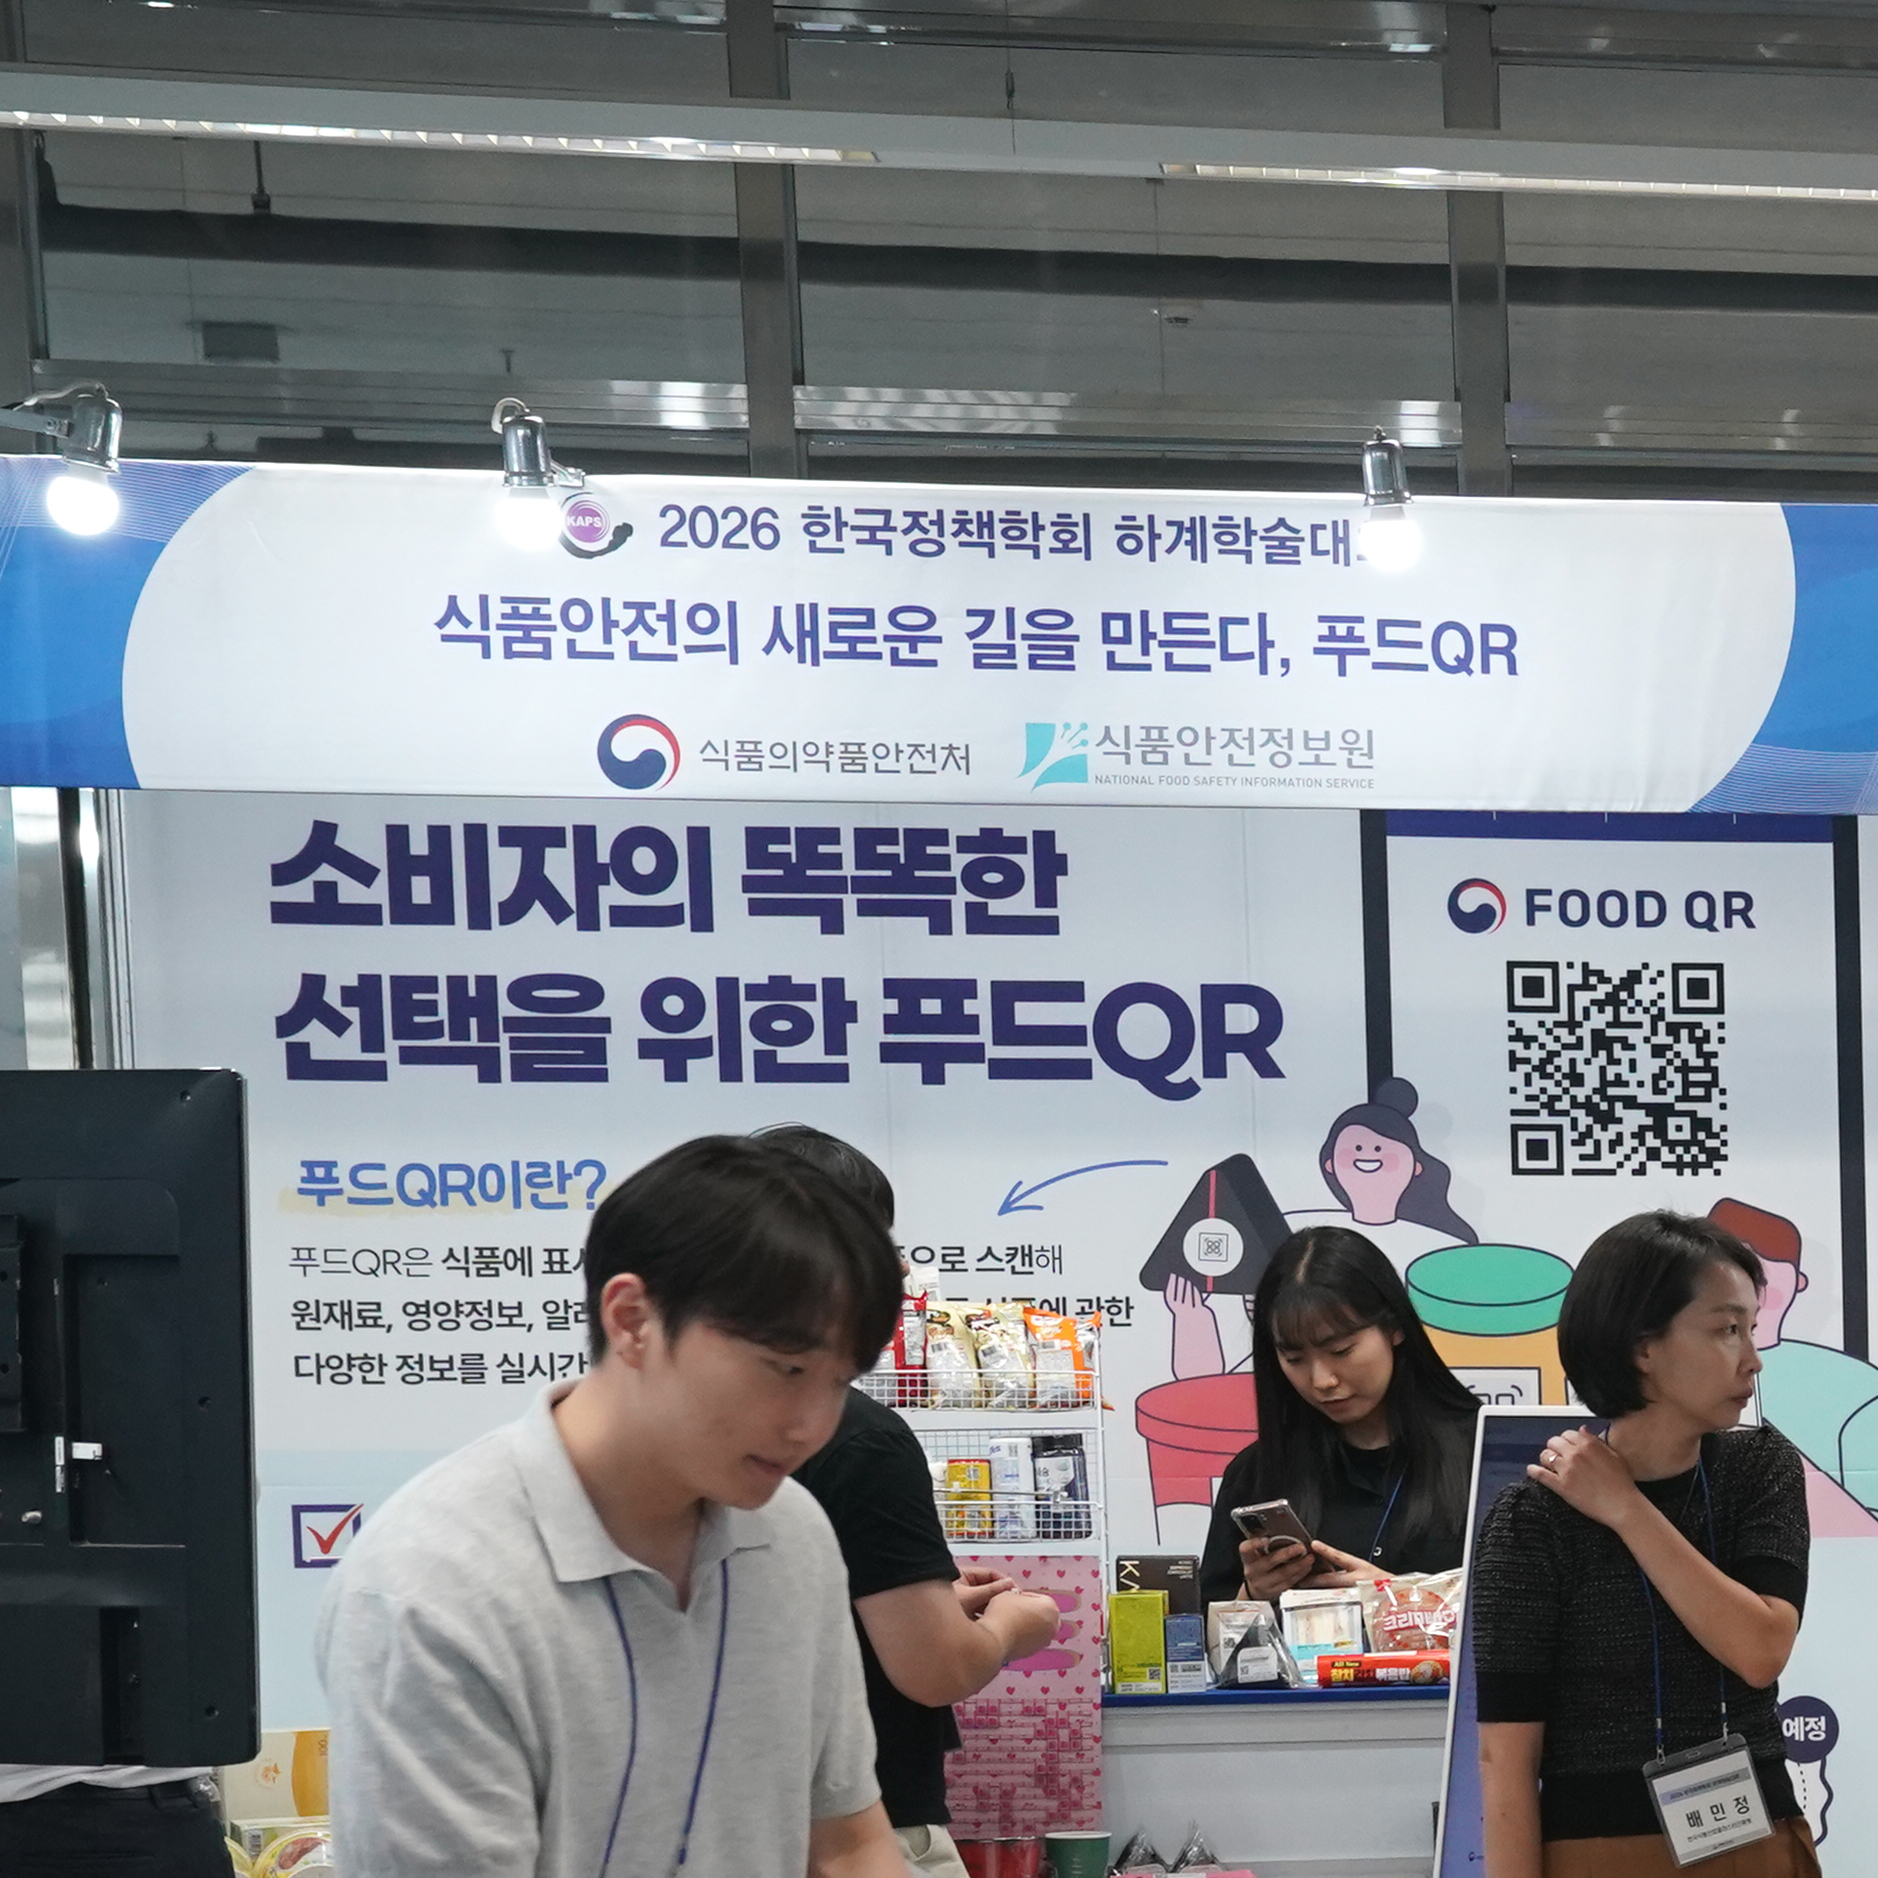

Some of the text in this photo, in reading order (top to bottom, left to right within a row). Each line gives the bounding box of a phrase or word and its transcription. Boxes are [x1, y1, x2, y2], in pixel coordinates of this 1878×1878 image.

[565, 513, 603, 529] KAPS
[660, 504, 1360, 566] 2026 한국정책학회 하계학술대
[435, 594, 1518, 679] 식품안전의 새로운 길을 만든다, 푸드QR
[700, 725, 1373, 775] 식품의약품안전처 식품안전정보원
[1095, 775, 1373, 789] NATIONAL FOOD SAFETY INFORMATION SERVICE
[270, 820, 1067, 936] 소비자의 똑똑한
[1526, 889, 1756, 932] FOOD QR
[275, 973, 1285, 1100] 선택을 위한 푸드QR
[297, 1159, 610, 1214] 푸드QR이란?
[290, 1246, 532, 1277] 푸드QR은 식품에
[976, 1245, 1062, 1275] 스캔해
[292, 1299, 533, 1333] 원재료, 영양정보,
[295, 1353, 387, 1385] 다양한
[396, 1354, 488, 1384] 정보를
[1779, 1716, 1825, 1743] 예정
